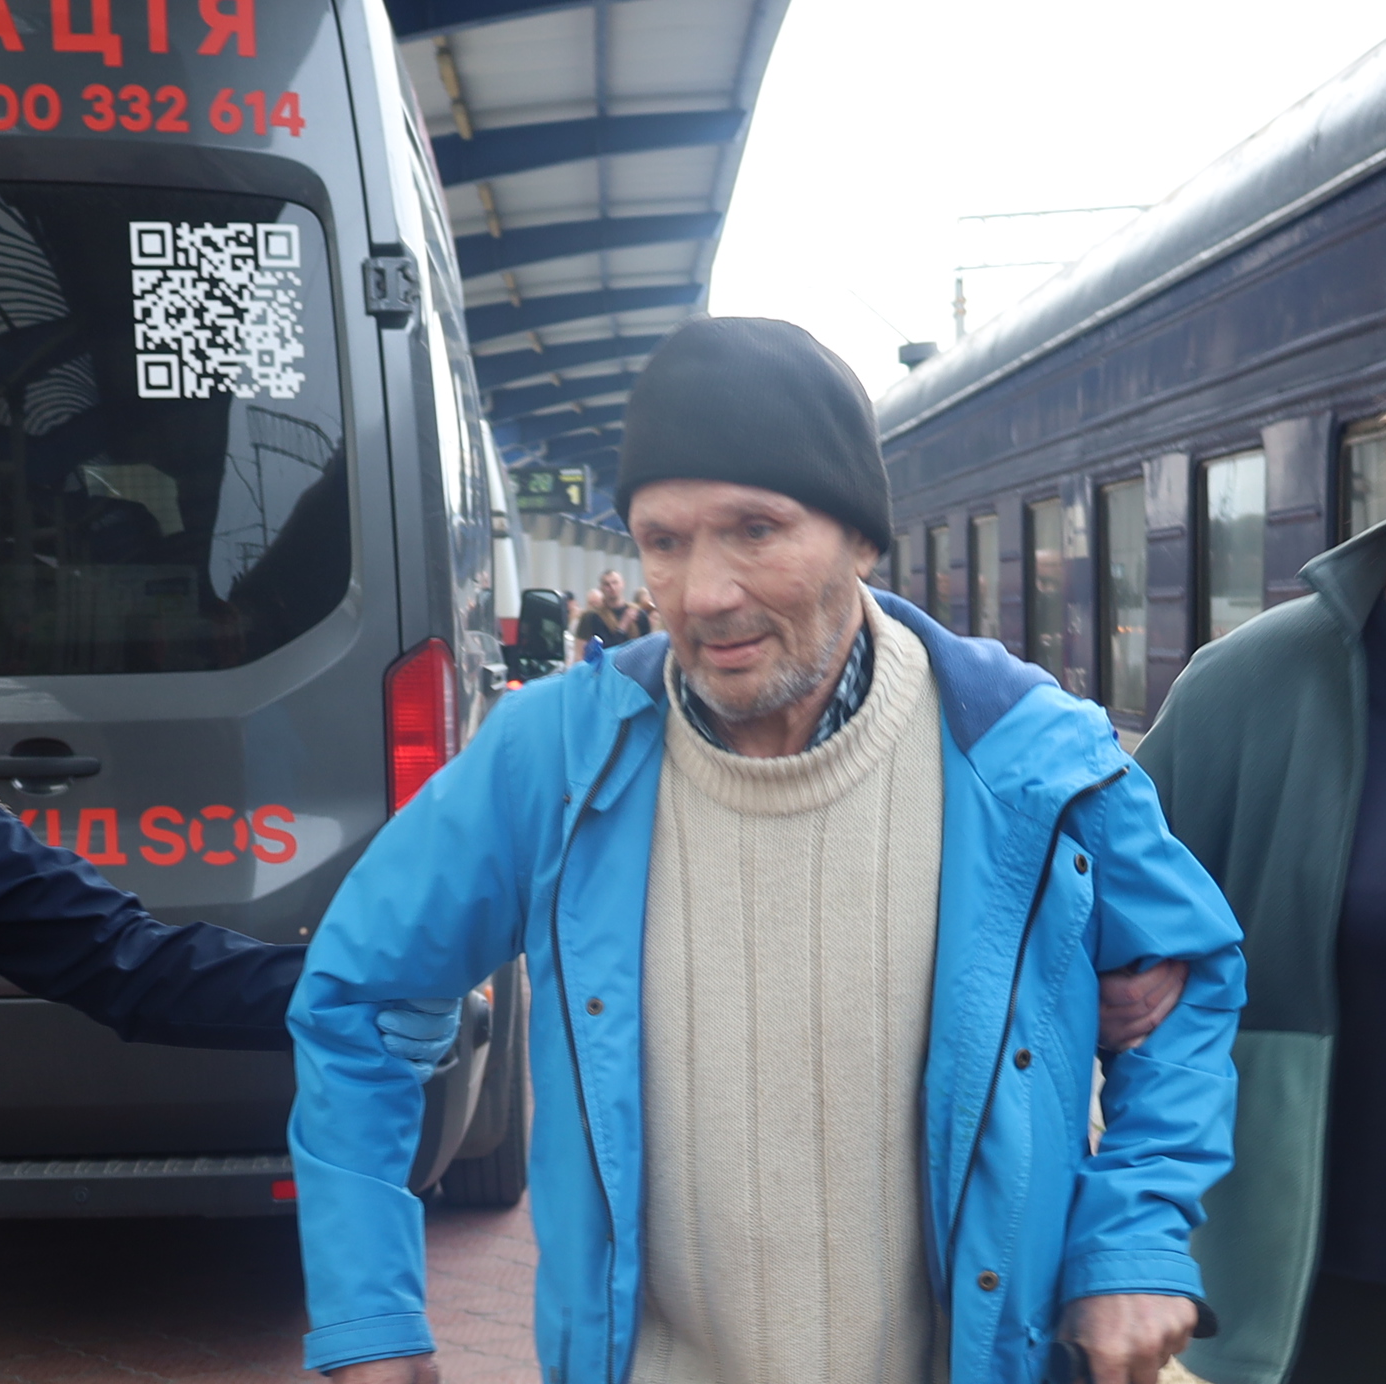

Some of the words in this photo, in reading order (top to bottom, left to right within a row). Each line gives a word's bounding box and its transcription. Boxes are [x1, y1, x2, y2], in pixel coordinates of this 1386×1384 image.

[81, 84, 190, 133] 332
[208, 88, 306, 137] 614
[19, 807, 128, 866] ІД
[139, 804, 298, 866] SOS
